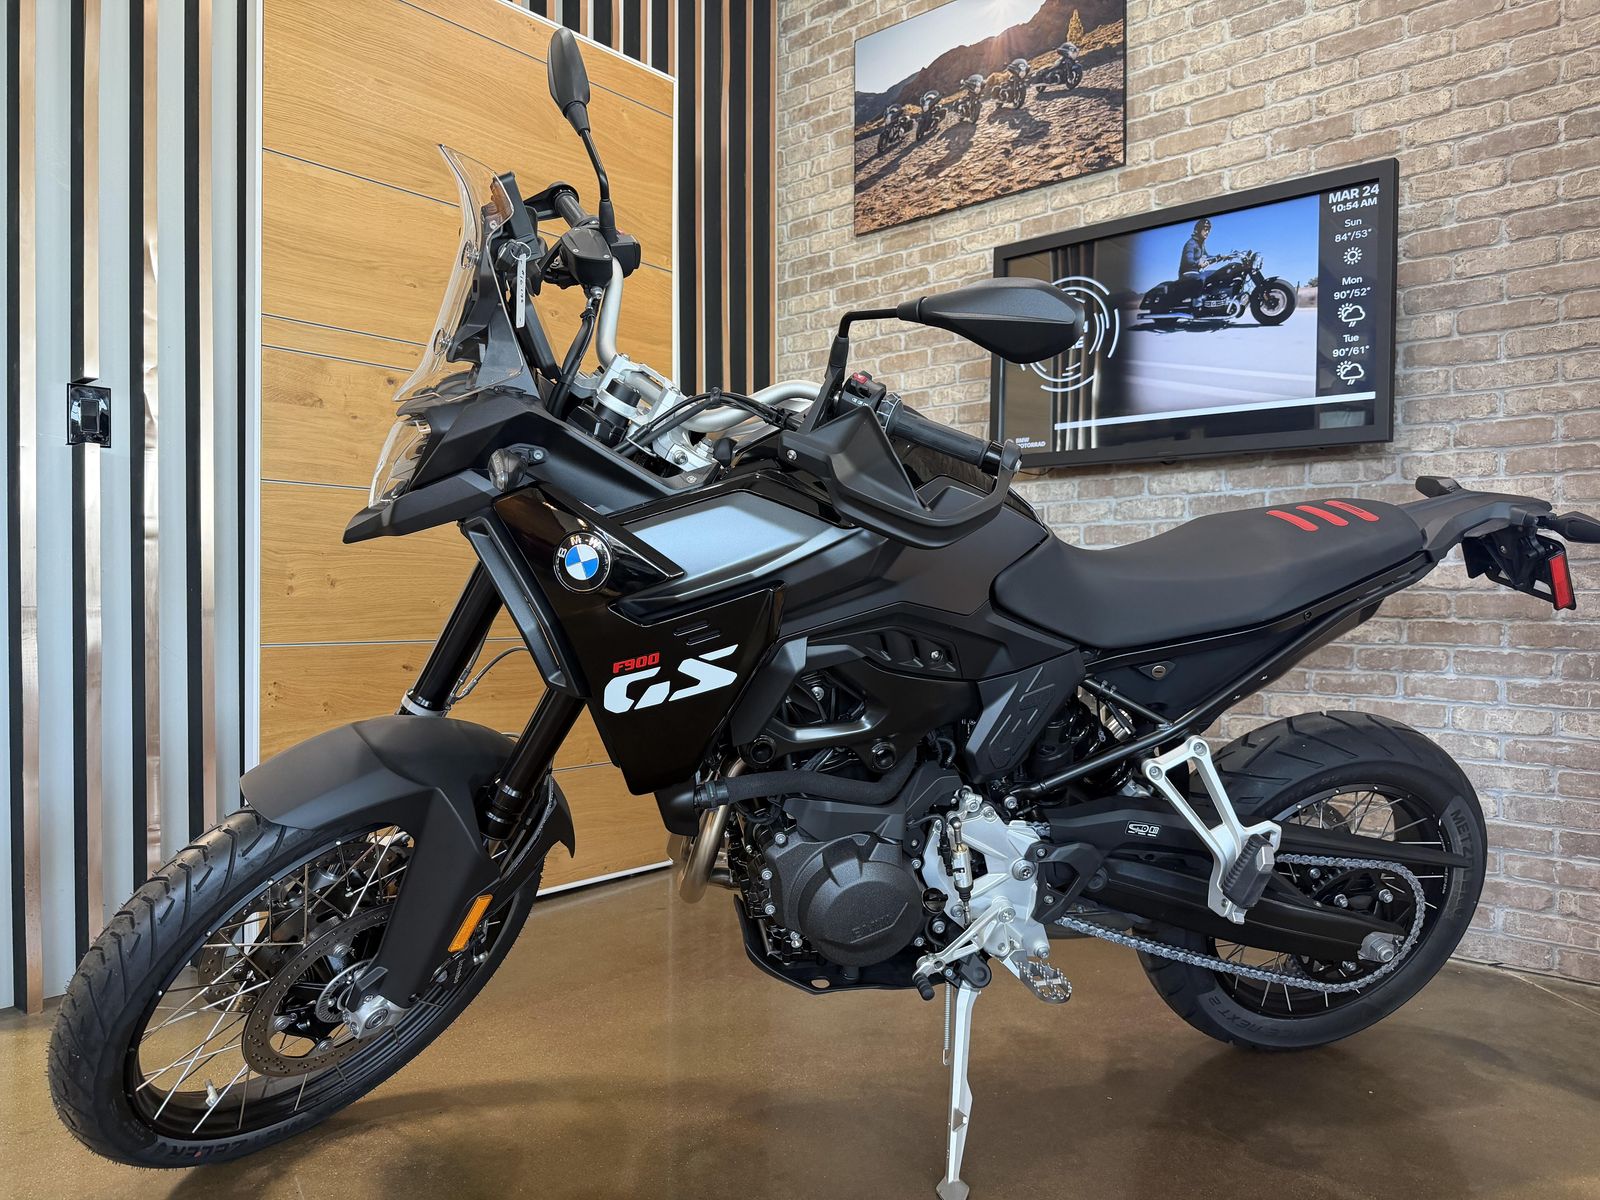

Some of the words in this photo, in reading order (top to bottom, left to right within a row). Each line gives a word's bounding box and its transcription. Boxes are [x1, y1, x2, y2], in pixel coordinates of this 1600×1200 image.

[1328, 188, 1360, 204] MAR
[1362, 184, 1380, 197] 24
[1331, 201, 1359, 213] 10:54
[1360, 197, 1378, 208] AM
[1344, 218, 1362, 228] Sun
[1341, 276, 1363, 286] Mon
[1343, 334, 1360, 343] Tue
[613, 651, 660, 674] F900
[603, 643, 739, 714] GS
